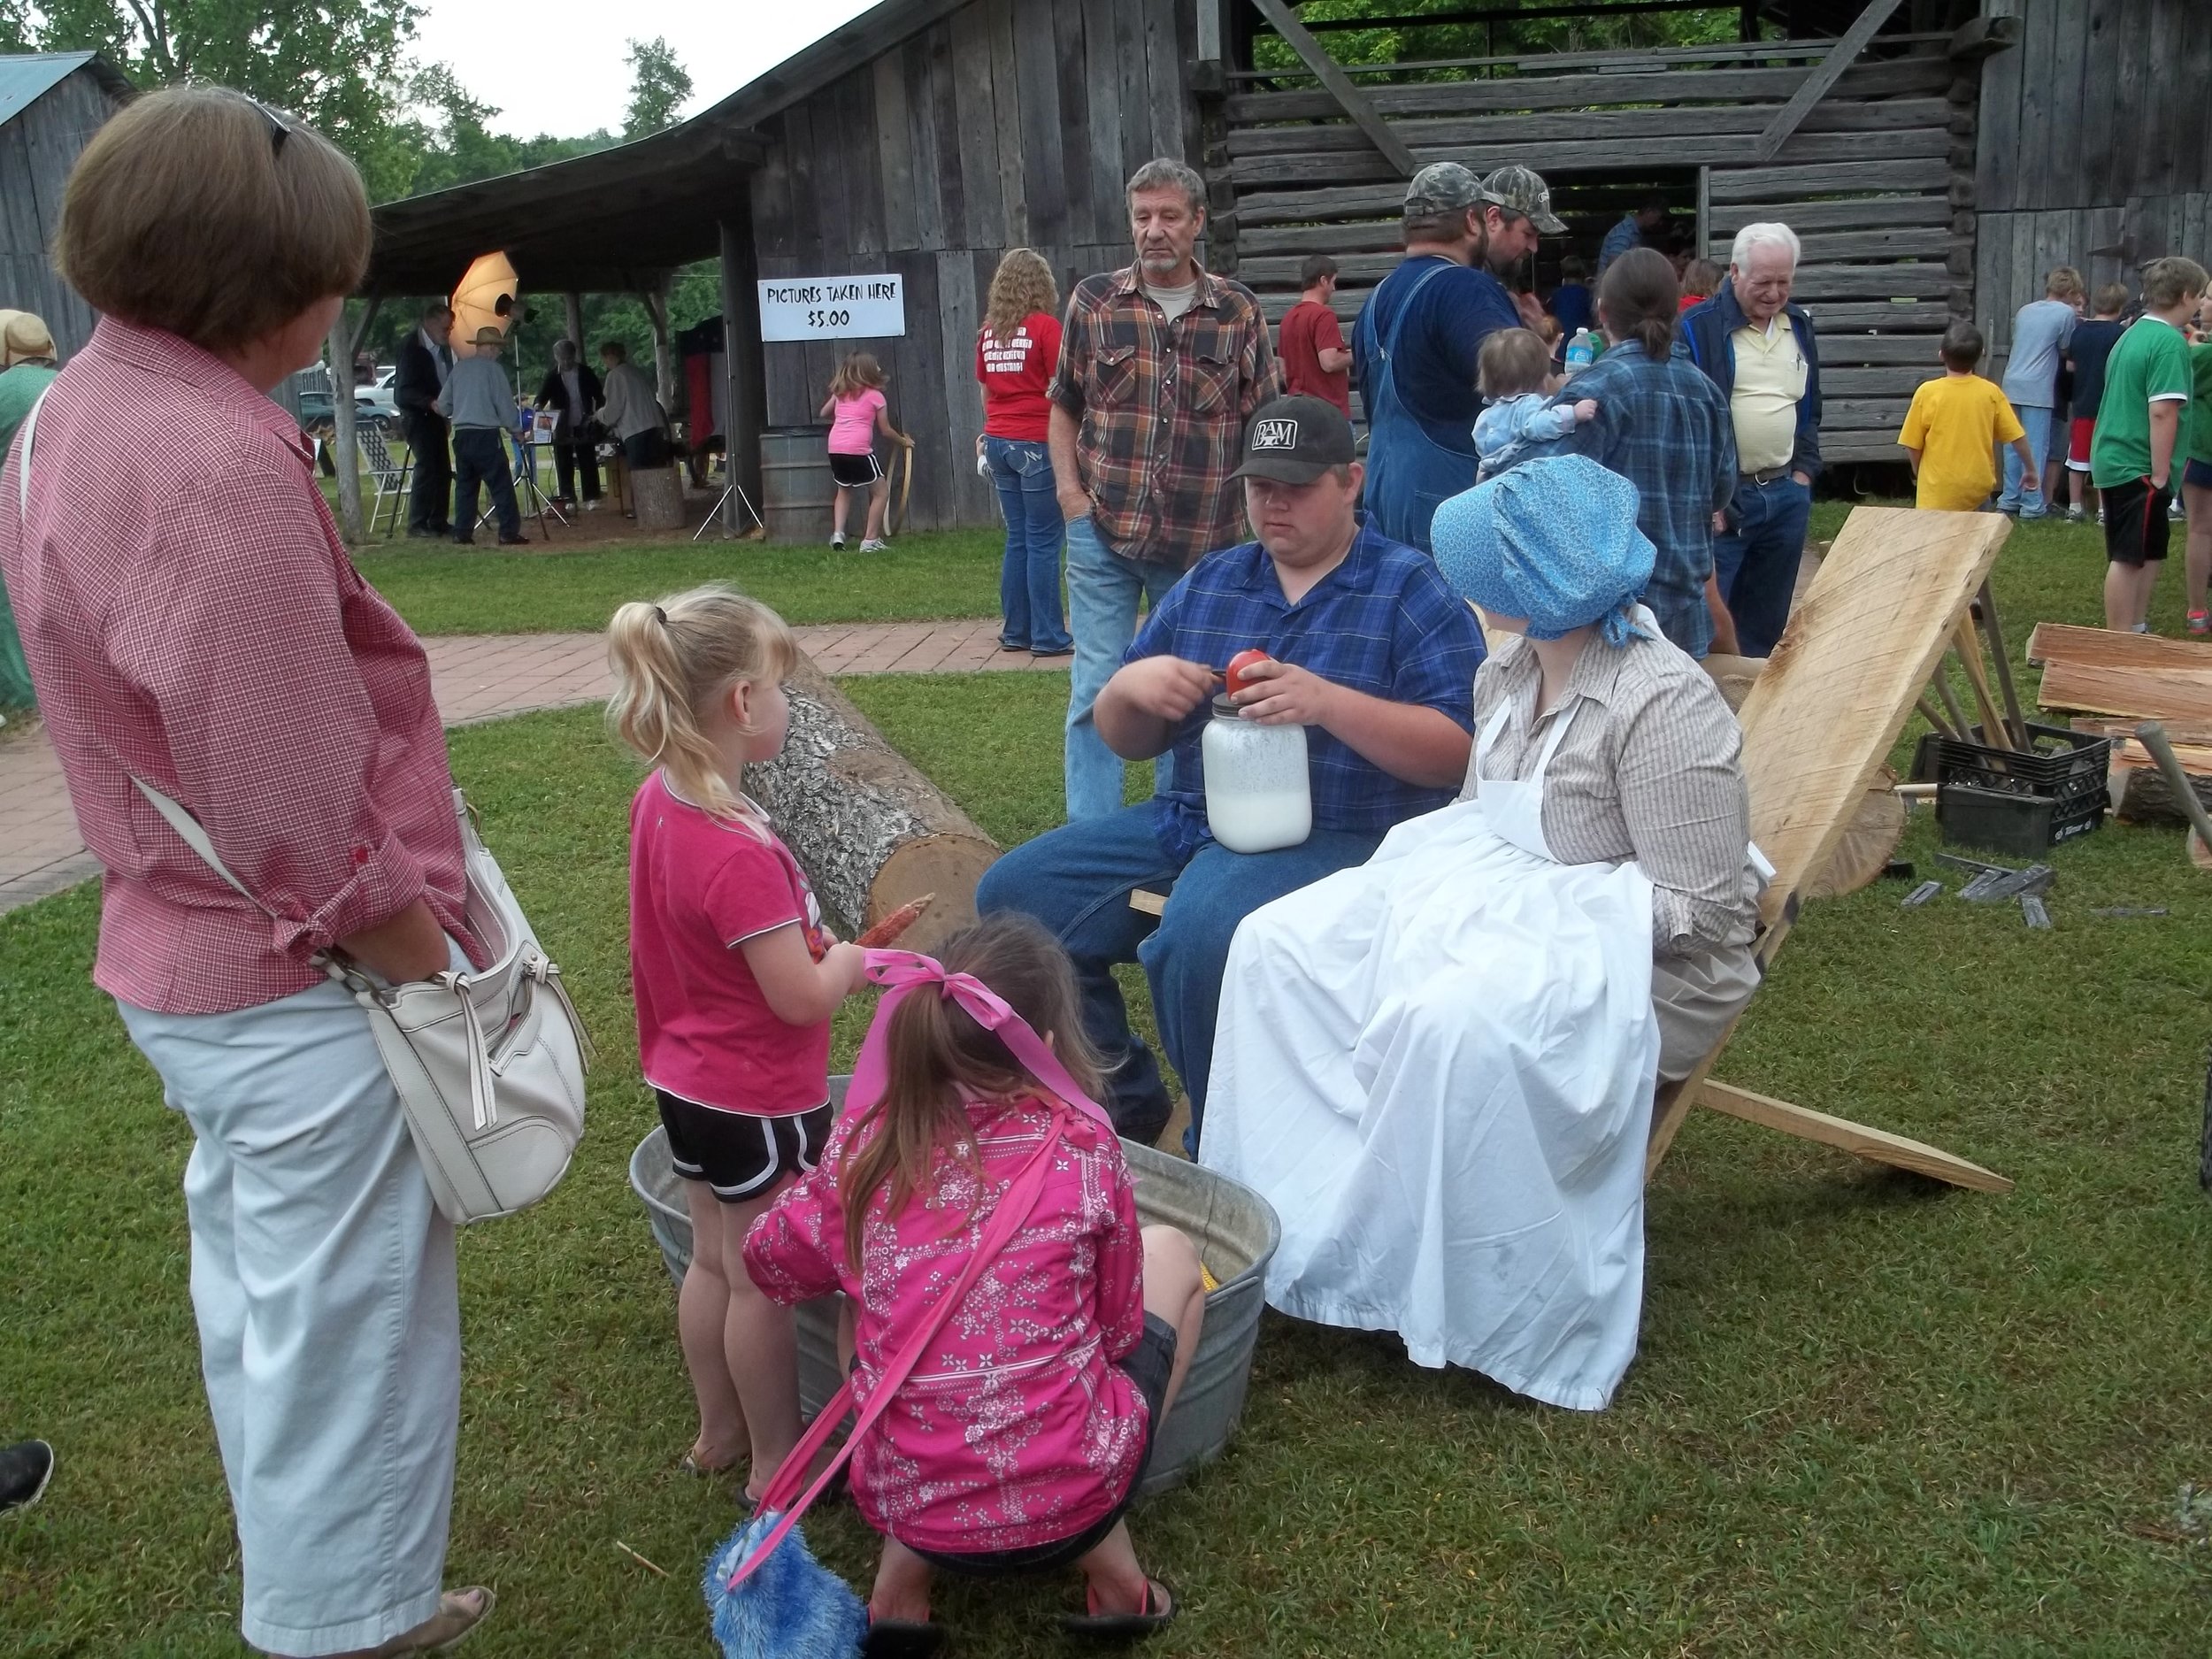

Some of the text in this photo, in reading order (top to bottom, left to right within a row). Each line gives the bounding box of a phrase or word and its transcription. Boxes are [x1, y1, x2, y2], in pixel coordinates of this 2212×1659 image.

[767, 282, 896, 304] PICTURES TAKEN HERE
[808, 310, 850, 328] $5.00
[1254, 421, 1294, 447] BAM
